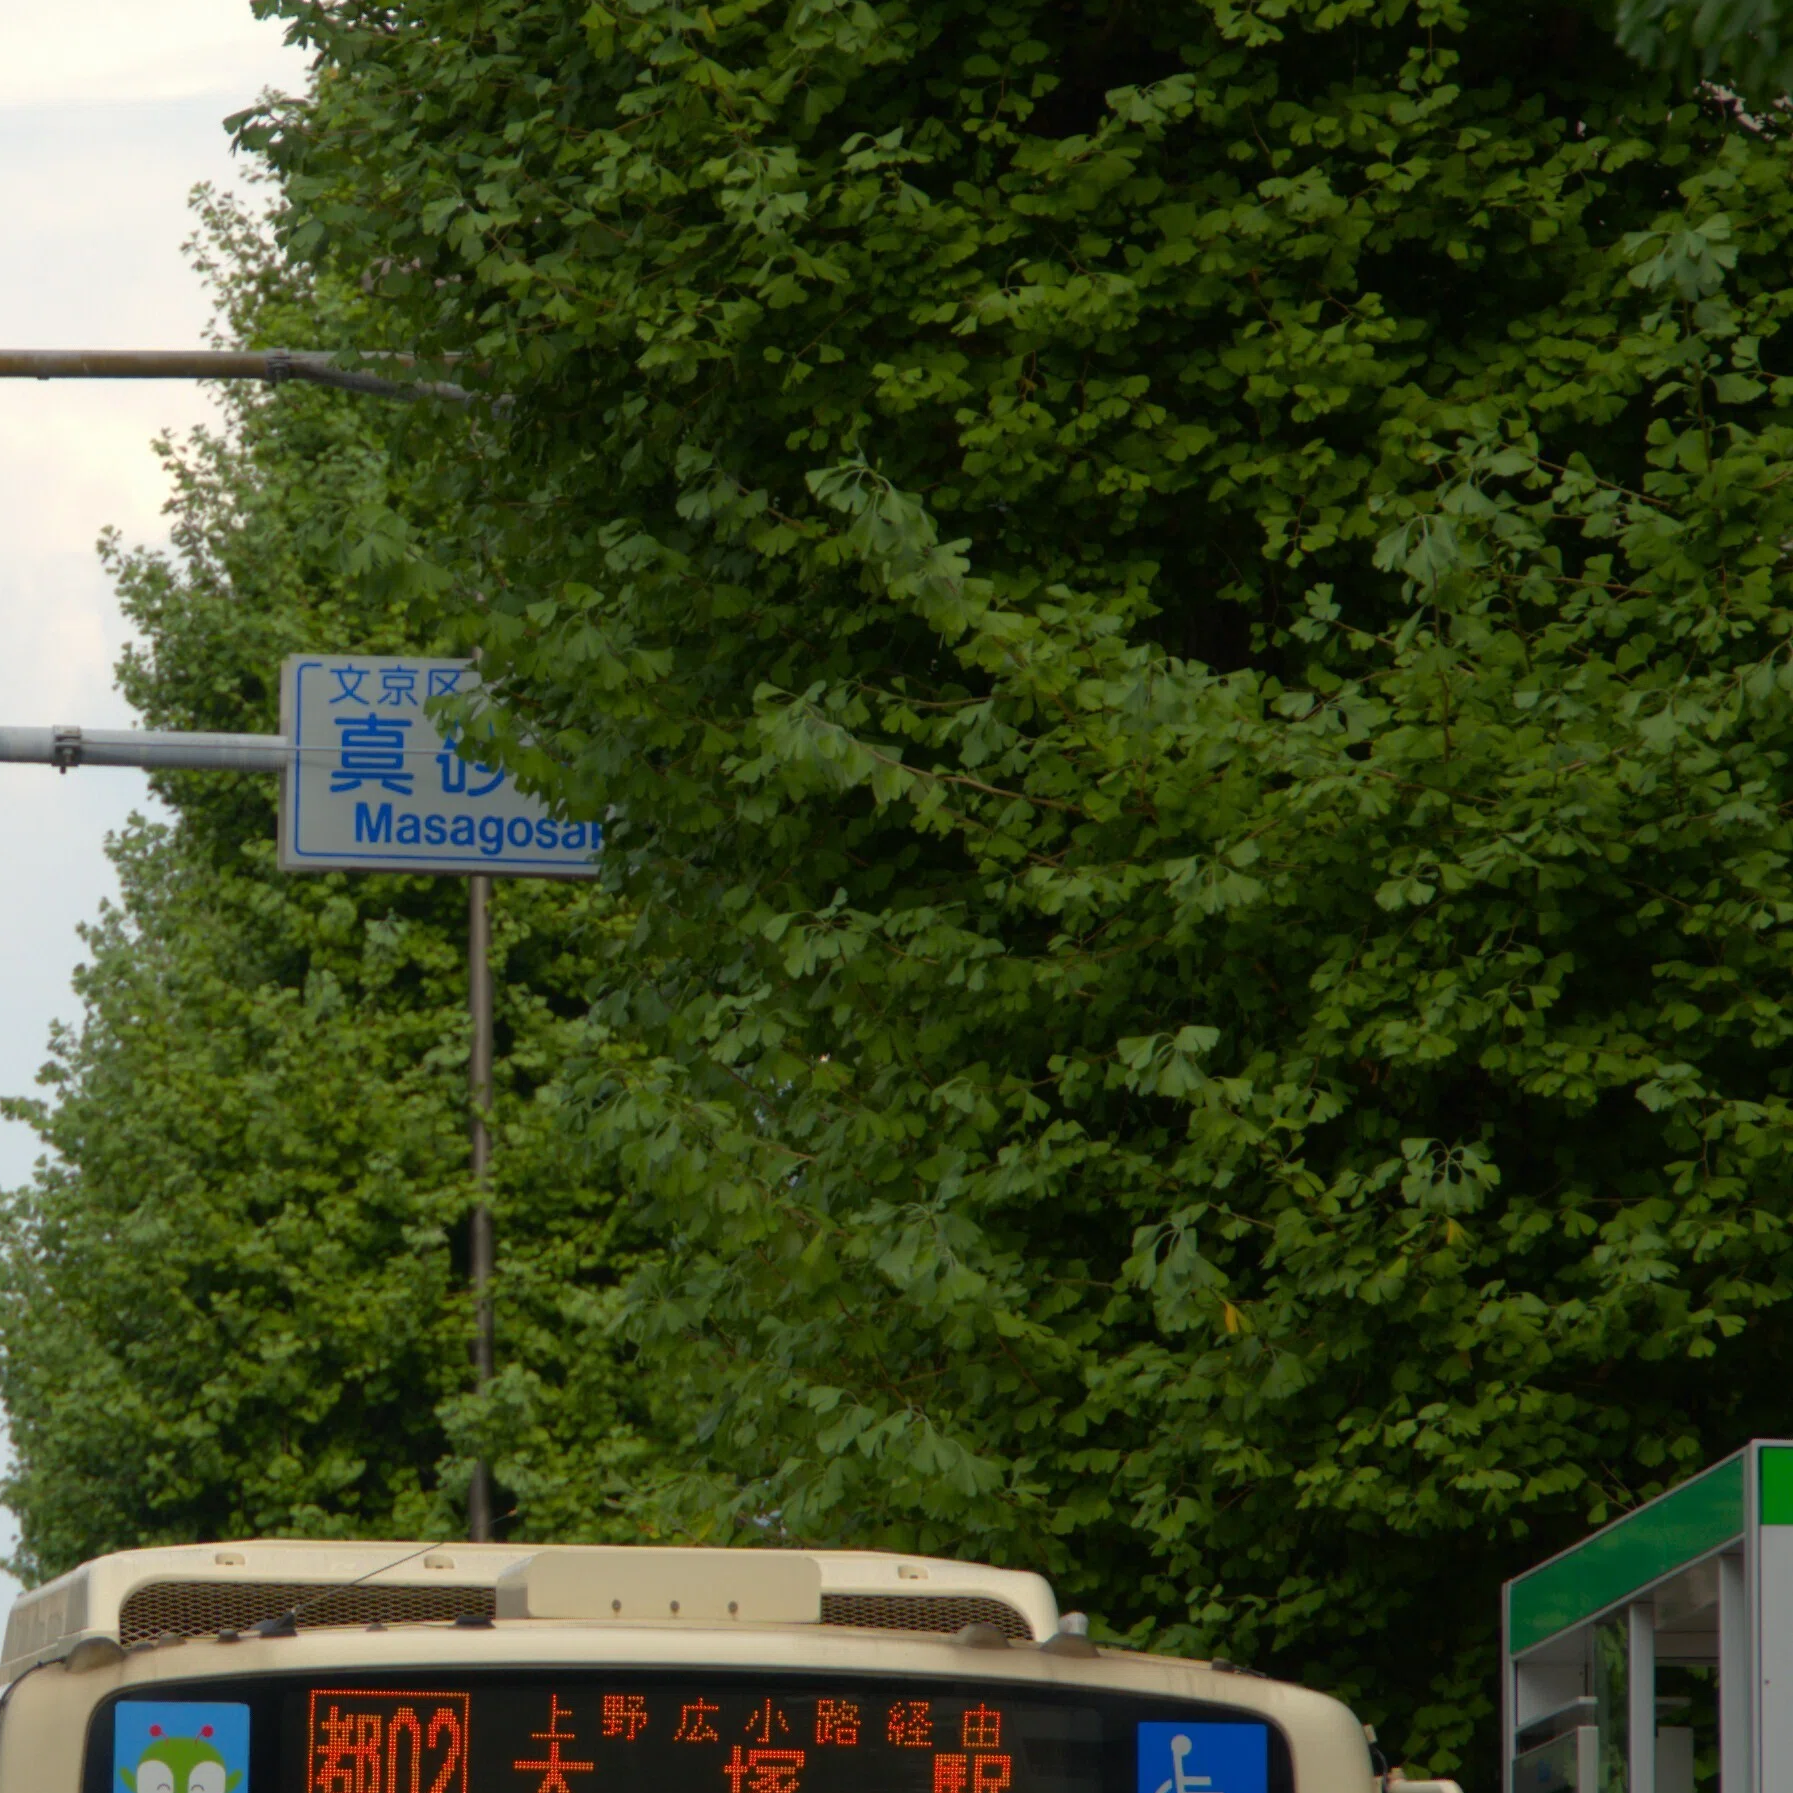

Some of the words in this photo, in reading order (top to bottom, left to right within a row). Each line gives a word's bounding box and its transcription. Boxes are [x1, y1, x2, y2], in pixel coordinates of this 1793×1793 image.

[531, 1693, 1002, 1748] 上野広小路経由
